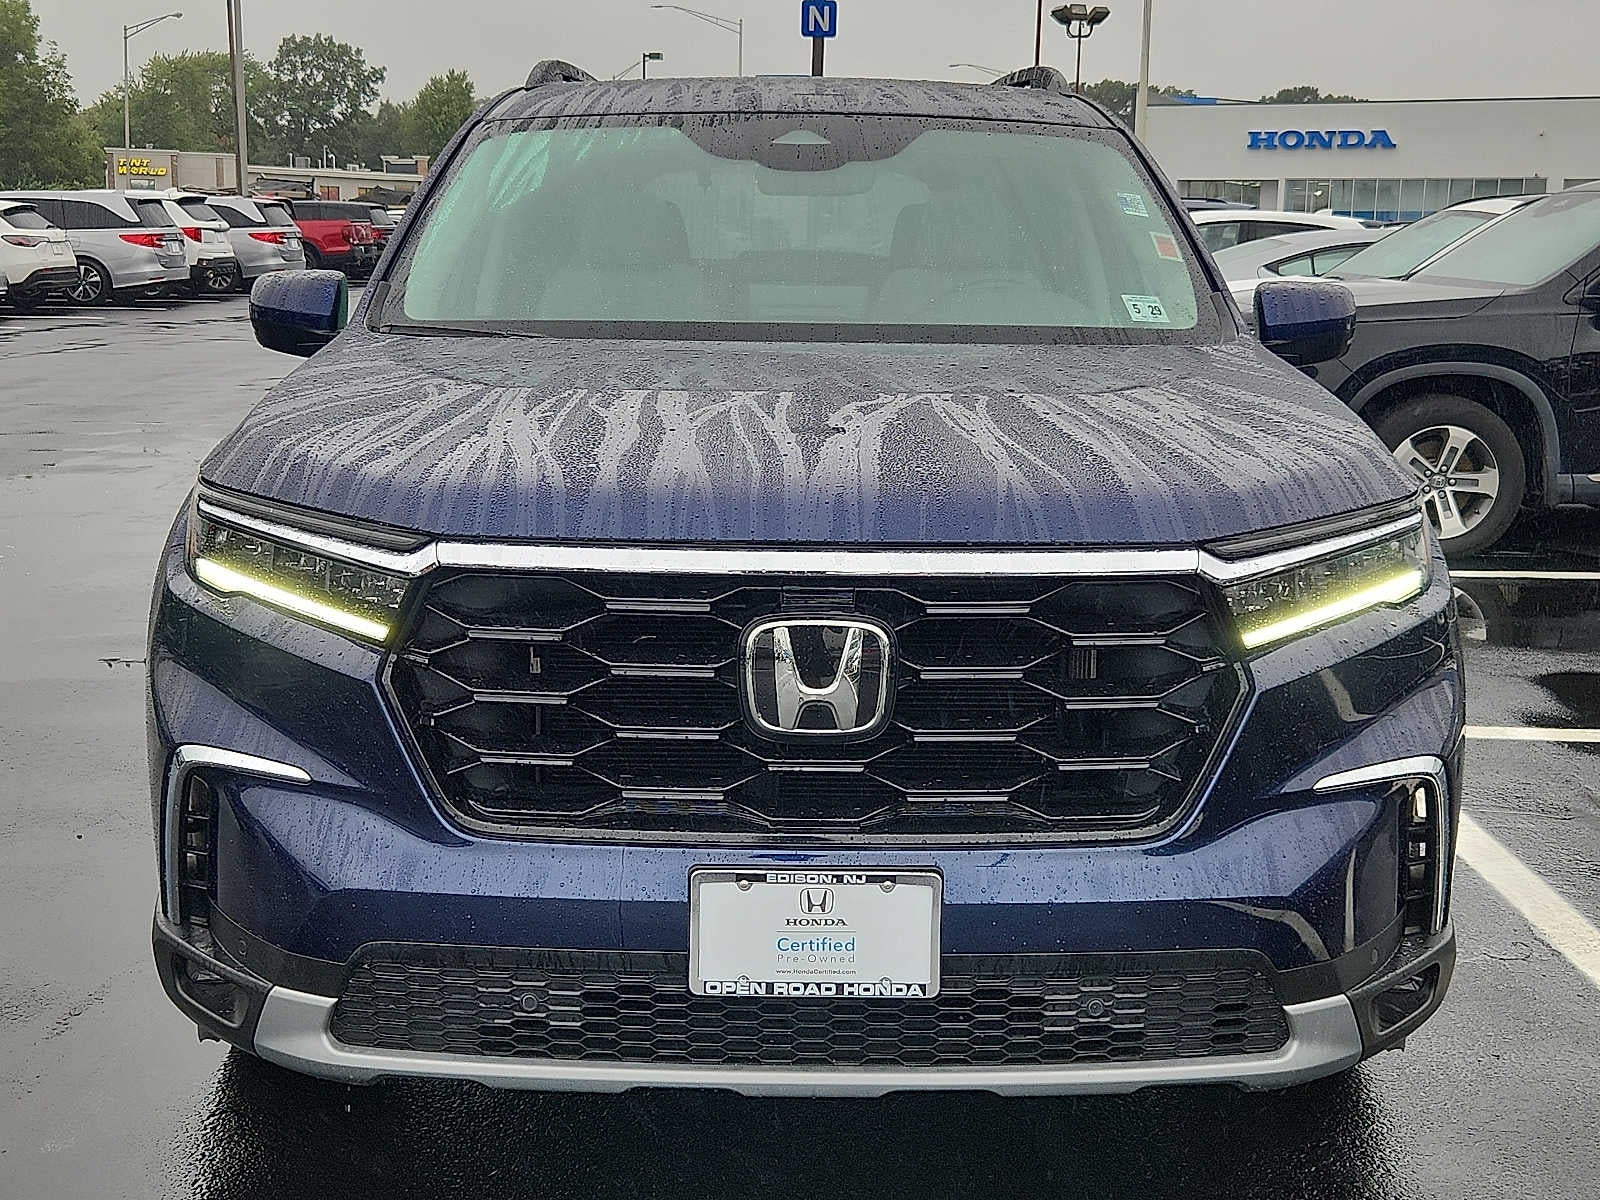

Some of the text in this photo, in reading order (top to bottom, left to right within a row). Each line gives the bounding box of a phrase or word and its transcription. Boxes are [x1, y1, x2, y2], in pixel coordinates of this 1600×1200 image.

[809, 5, 829, 31] N
[1247, 130, 1397, 150] HONDA
[118, 158, 151, 167] TNT
[118, 166, 167, 175] WORLD
[1132, 303, 1162, 315] 5 29
[766, 873, 867, 884] EDISON, NJ
[784, 918, 848, 927] HONDA
[777, 936, 855, 952] Certified
[777, 953, 855, 963] Pre-Owned
[705, 981, 923, 997] OPEN ROAD HONDA
